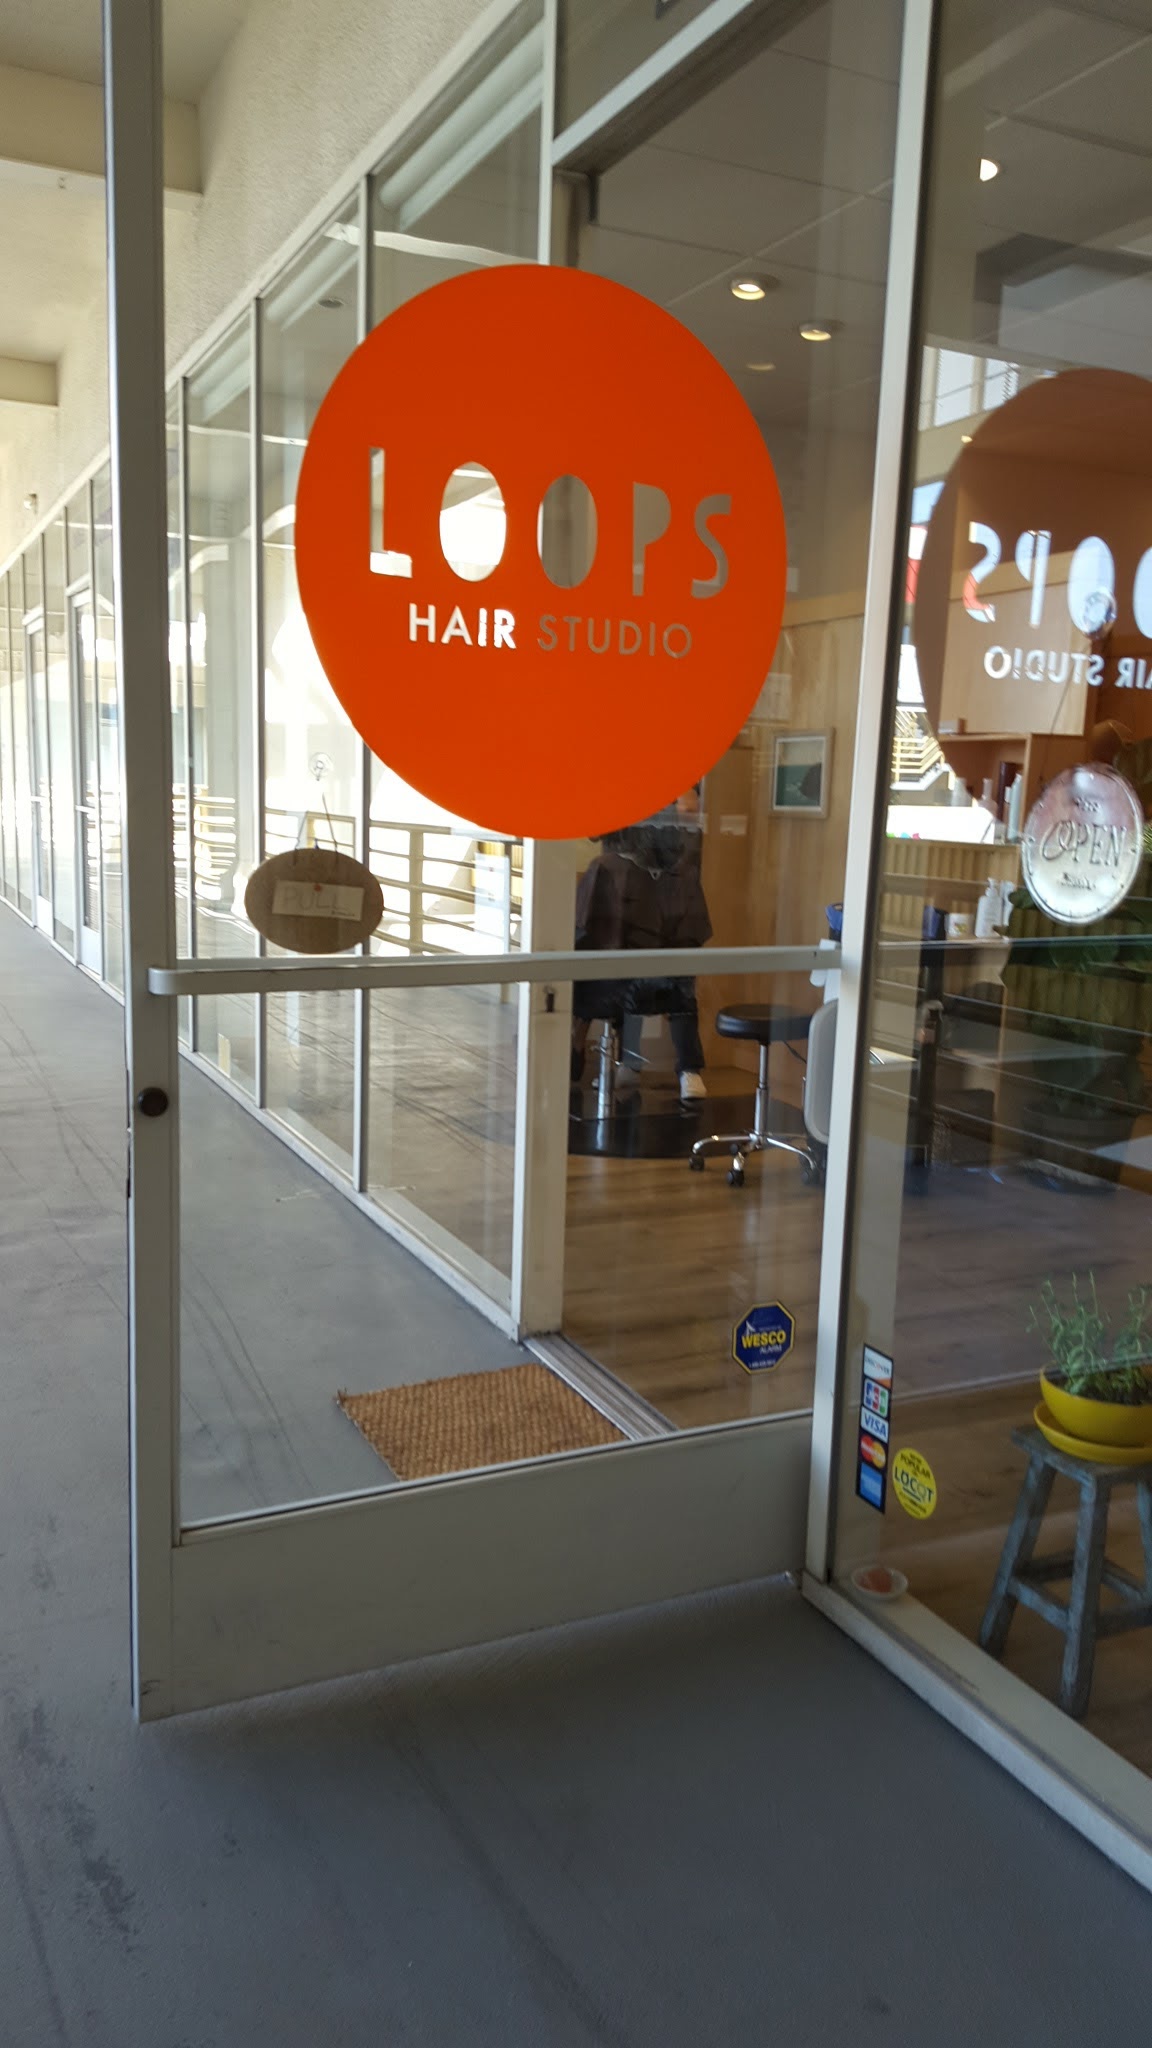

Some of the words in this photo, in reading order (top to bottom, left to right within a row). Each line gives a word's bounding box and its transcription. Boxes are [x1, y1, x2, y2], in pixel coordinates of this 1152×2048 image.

[369, 447, 732, 599] LOOPS
[408, 603, 516, 649] HAIR
[537, 614, 692, 659] STUDIO
[1039, 820, 1127, 867] OPEN
[283, 885, 346, 911] PULL
[741, 1330, 787, 1349] WESCO
[864, 1412, 886, 1438] VISA
